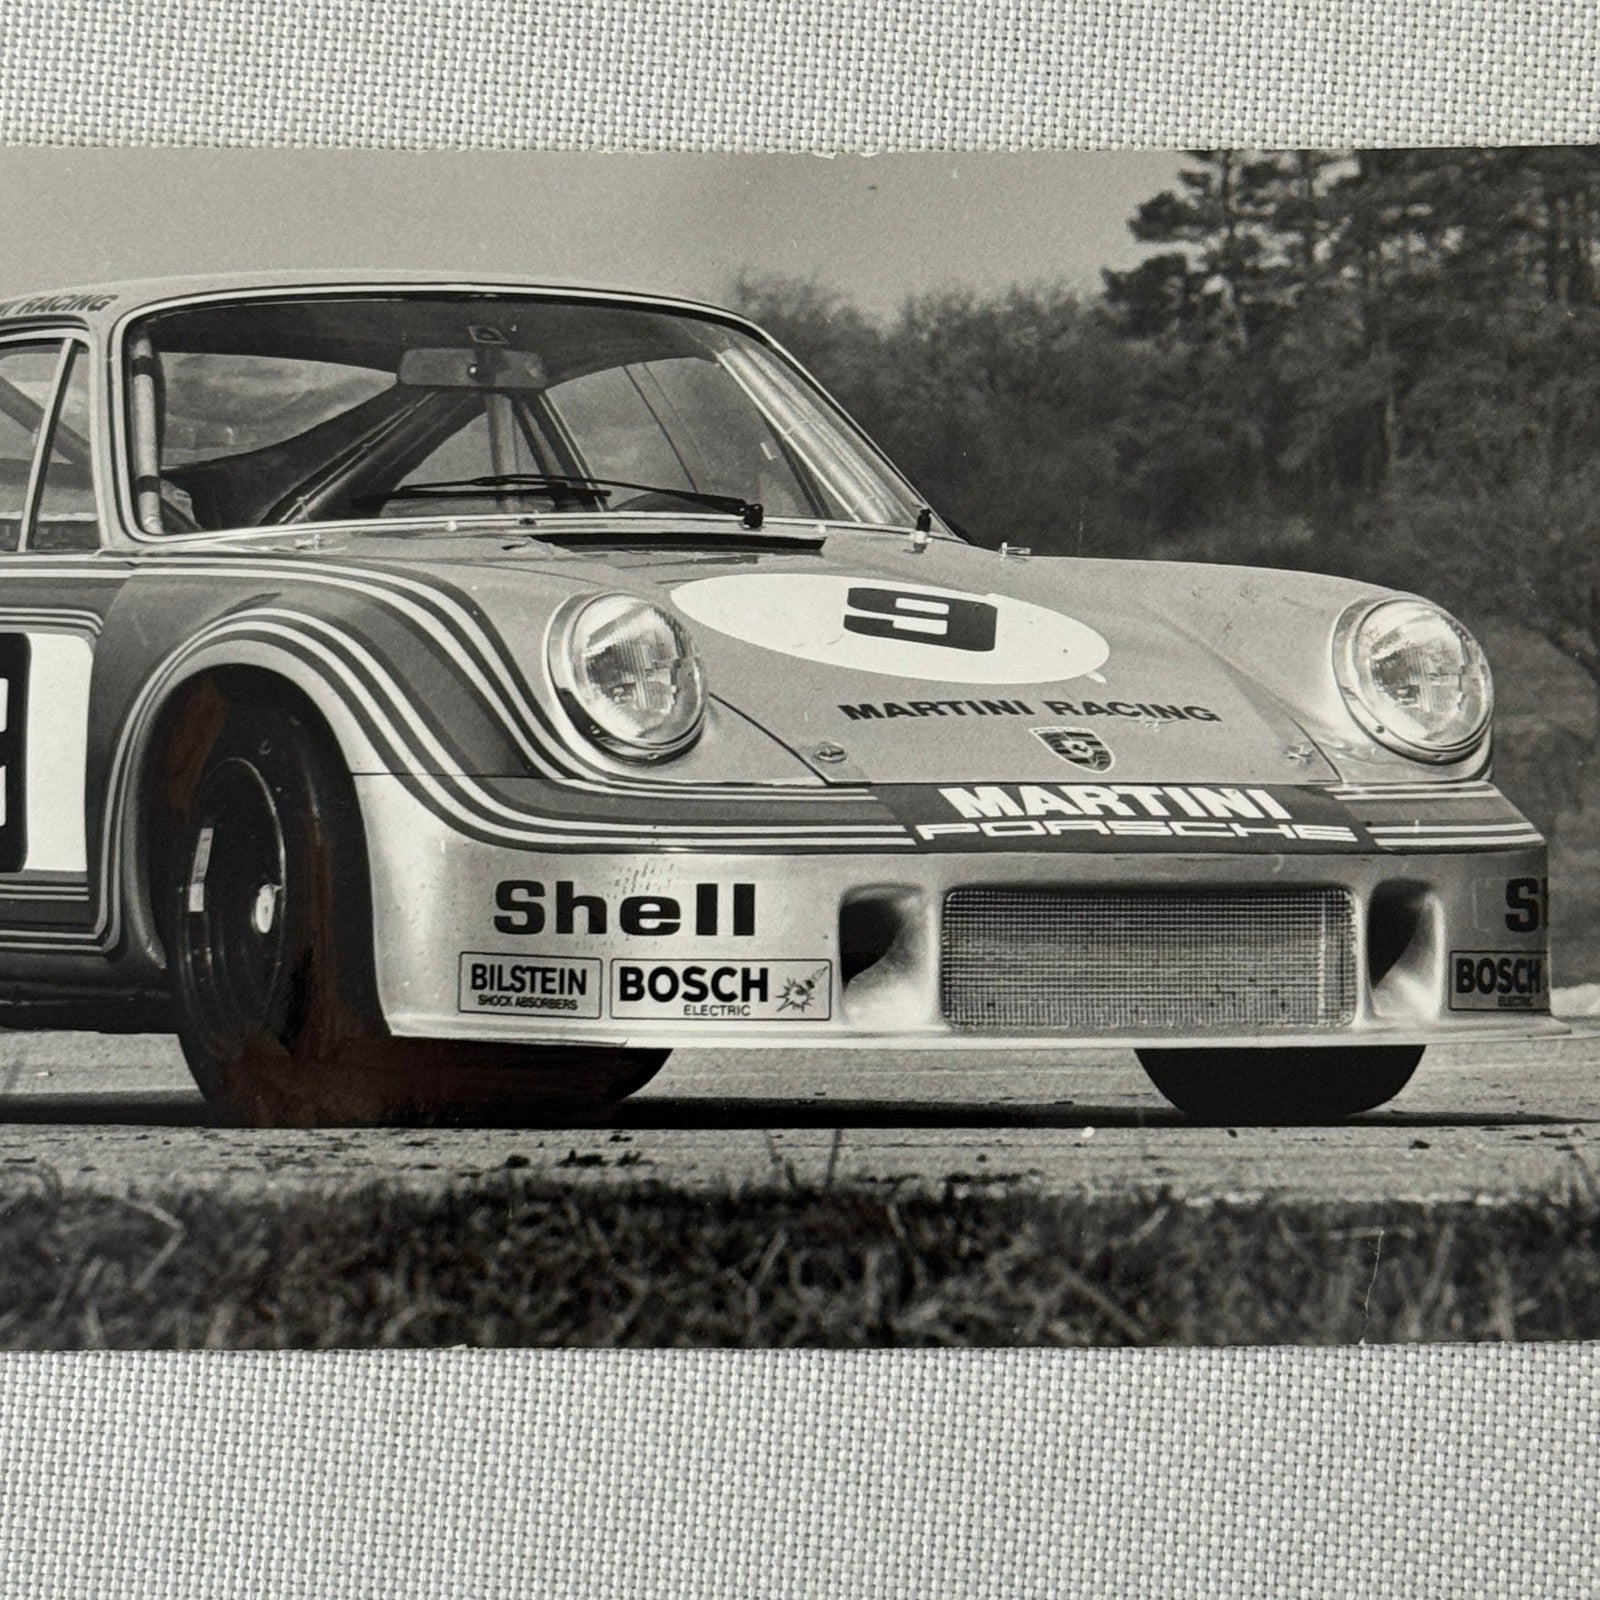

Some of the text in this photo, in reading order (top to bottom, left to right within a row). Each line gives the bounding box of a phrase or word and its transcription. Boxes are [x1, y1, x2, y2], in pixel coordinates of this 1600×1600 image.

[15, 294, 119, 314] RACING
[843, 587, 998, 652] 9
[838, 699, 1222, 722] MARTINI RACING
[938, 785, 1293, 819] MARTINI
[915, 821, 1358, 842] PORSCHE
[493, 879, 756, 937] Shell
[471, 963, 587, 996] BILSTEIN
[619, 965, 769, 1003] BOSCH
[1455, 957, 1542, 995] BOSCH
[478, 994, 578, 1011] SHOCK ABSORBERS
[683, 1003, 751, 1017] ELECTRIC
